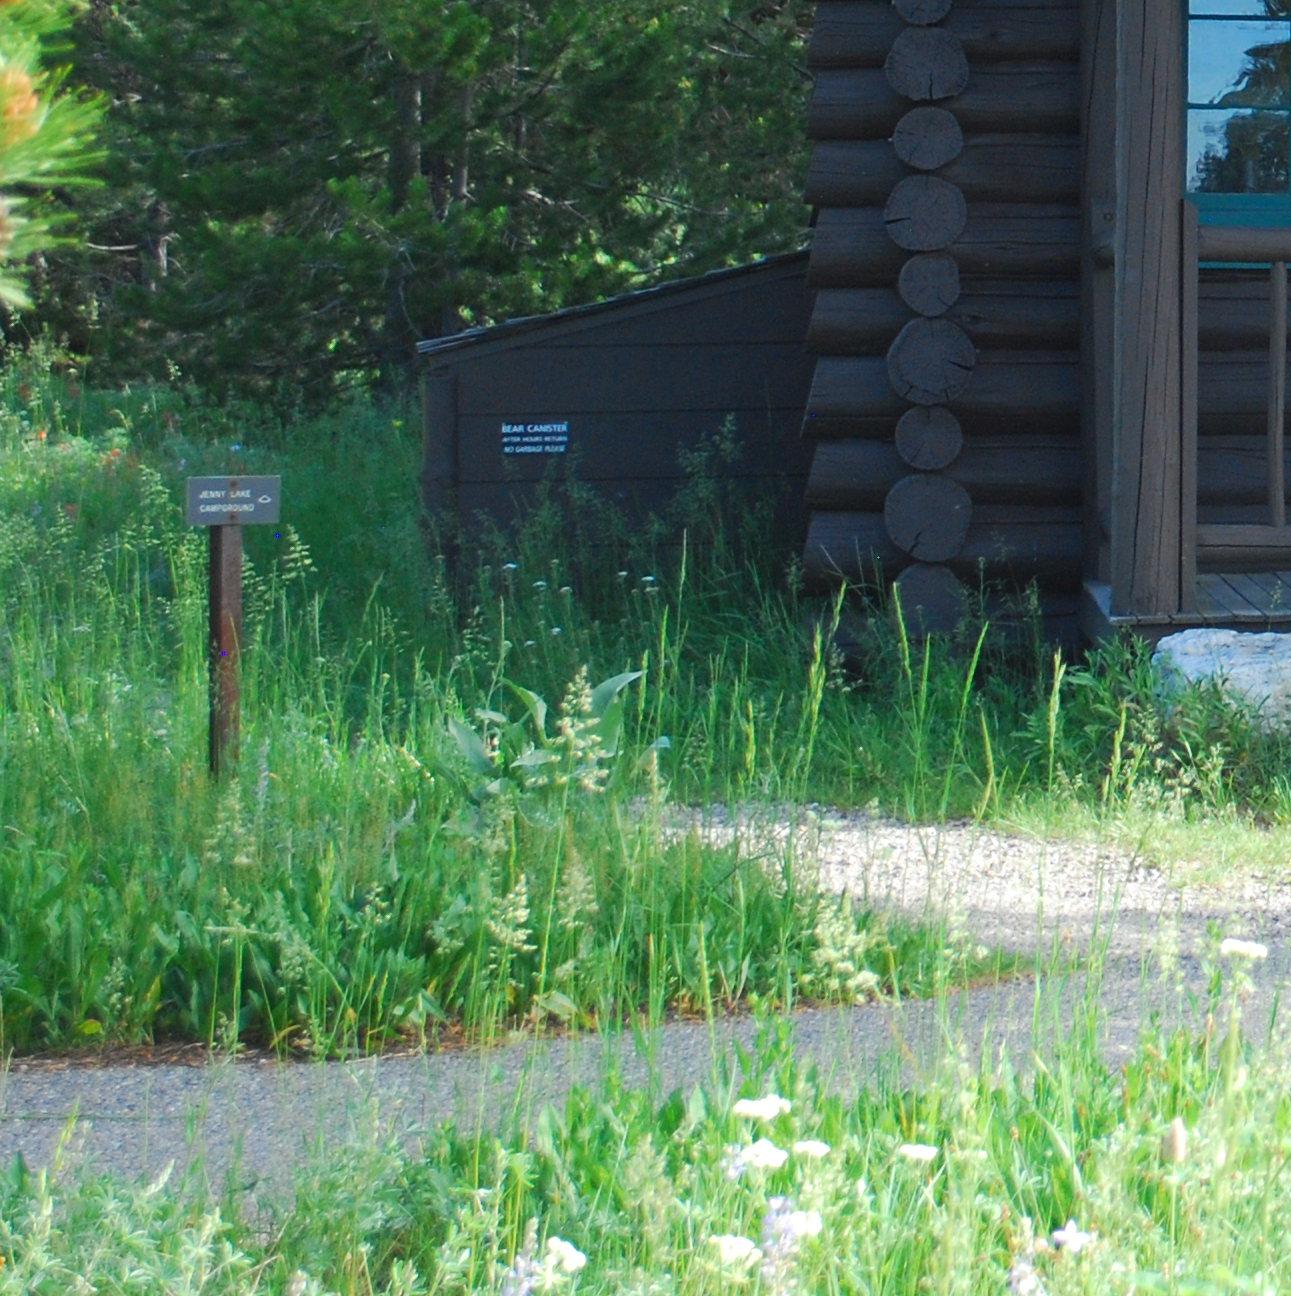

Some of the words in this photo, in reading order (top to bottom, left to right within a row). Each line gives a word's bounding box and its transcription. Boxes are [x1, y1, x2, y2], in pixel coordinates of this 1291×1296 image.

[502, 424, 525, 433] BEAR
[527, 424, 568, 433] CANISTER
[200, 490, 226, 499] JENNY
[230, 489, 251, 498] LAKE
[200, 504, 255, 512] CAMPGROUND
